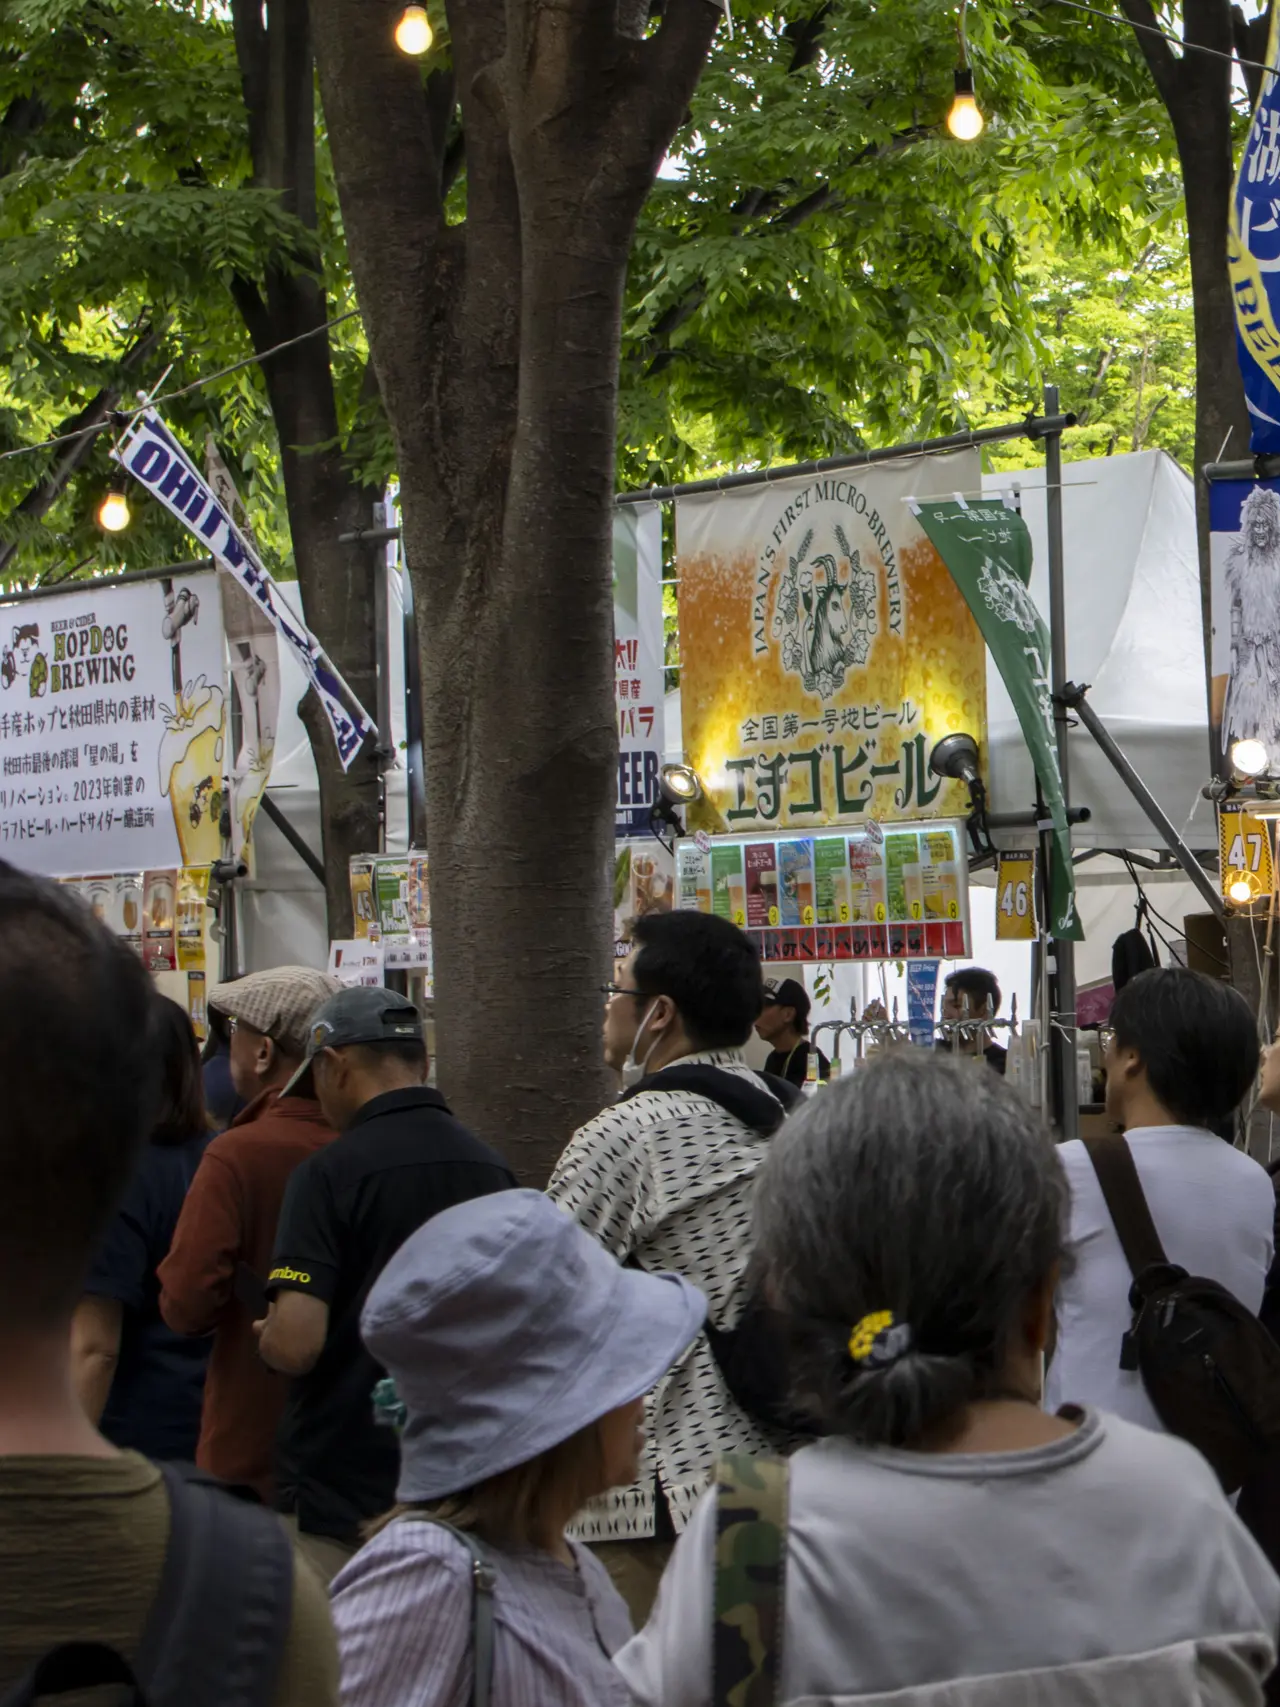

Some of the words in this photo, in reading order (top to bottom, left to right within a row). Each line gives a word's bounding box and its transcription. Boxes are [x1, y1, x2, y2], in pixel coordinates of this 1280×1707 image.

[754, 545, 777, 655] JAPAN'S
[772, 488, 811, 547] FIRST
[815, 480, 902, 635] MICRO-BREWERY
[50, 655, 136, 693] BREWING
[614, 679, 642, 700] 県産
[0, 694, 156, 739] 手産ホップと秋田県内の素材
[741, 701, 918, 743] 全国第一号地ビール
[725, 732, 942, 821] エチゴビール
[0, 807, 155, 842] ラフトビール・ハードサイダー醸造所
[1228, 833, 1263, 872] 47
[841, 905, 848, 920] 5
[876, 903, 884, 920] 6
[912, 902, 920, 919] 7
[949, 903, 957, 919] 8
[1001, 881, 1027, 917] 46
[736, 911, 743, 926] 2
[770, 908, 778, 921] 3
[804, 906, 812, 924] 4
